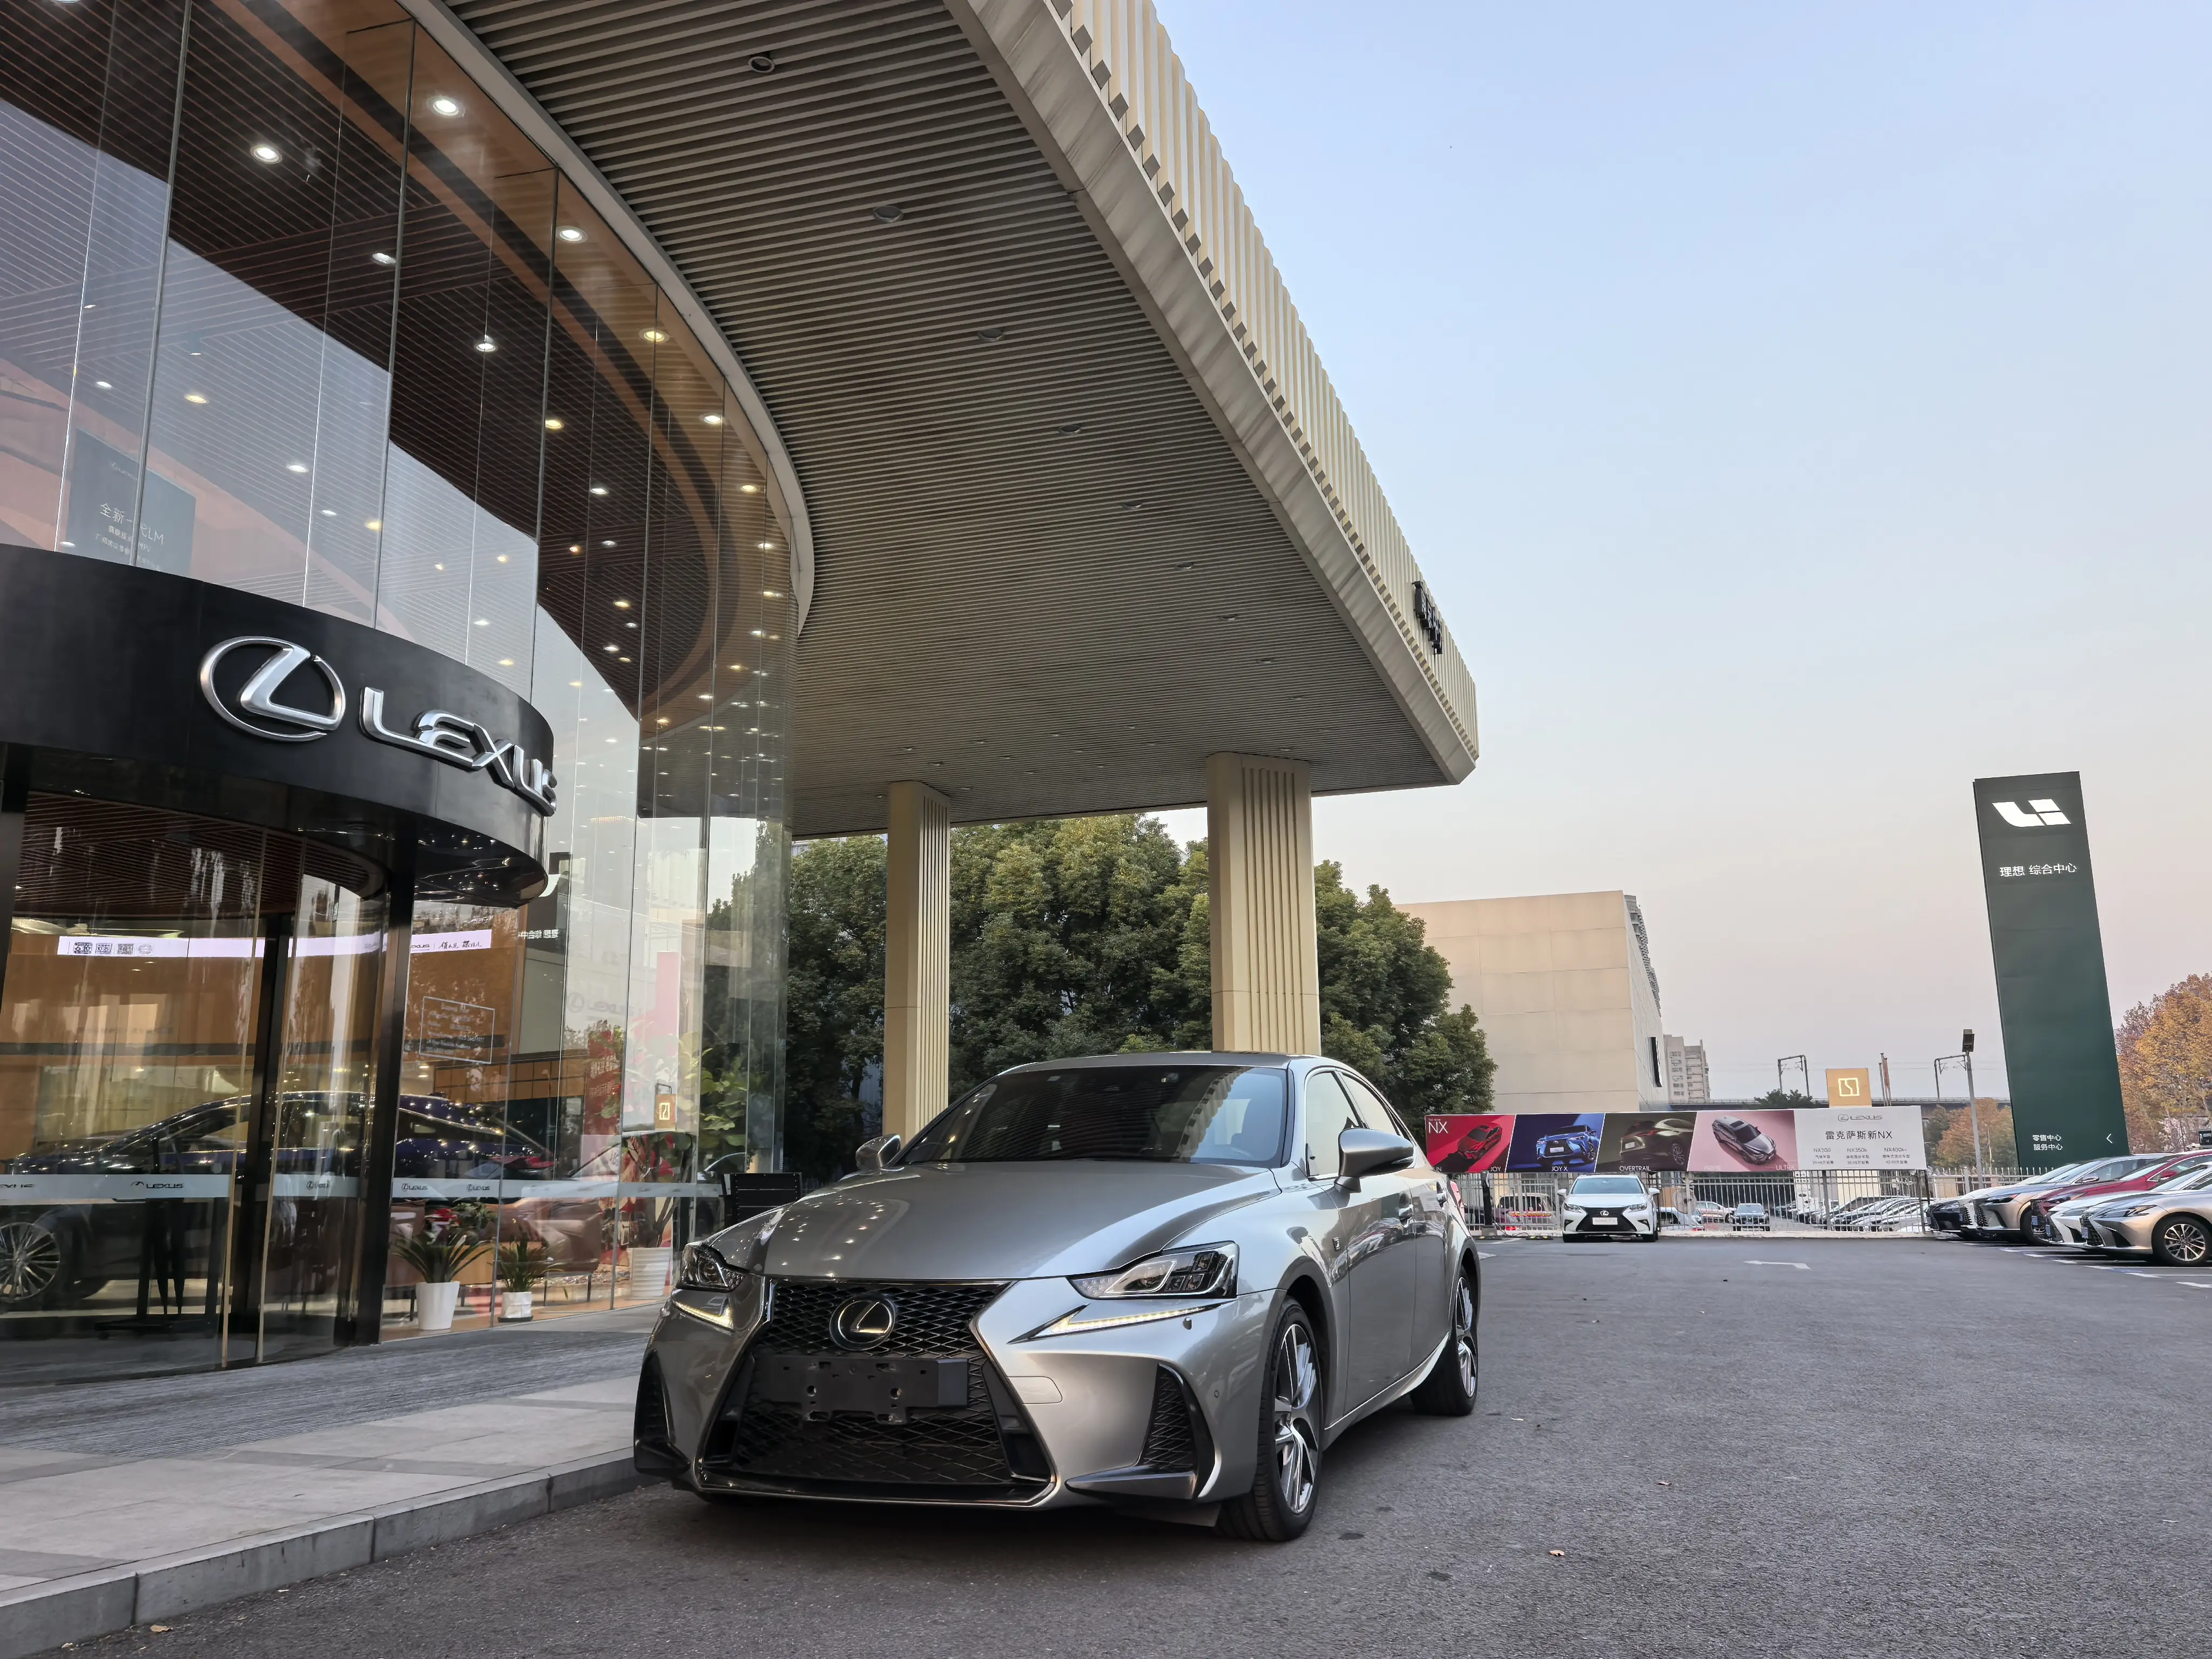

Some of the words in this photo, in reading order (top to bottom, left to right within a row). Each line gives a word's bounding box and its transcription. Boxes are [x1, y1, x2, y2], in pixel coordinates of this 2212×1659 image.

[359, 686, 557, 817] LEXUS
[1999, 866, 2025, 877] 理想
[2028, 862, 2078, 875] 综合中心
[1428, 1121, 1448, 1134] NX
[1825, 1130, 1893, 1140] 雷克萨斯新NX
